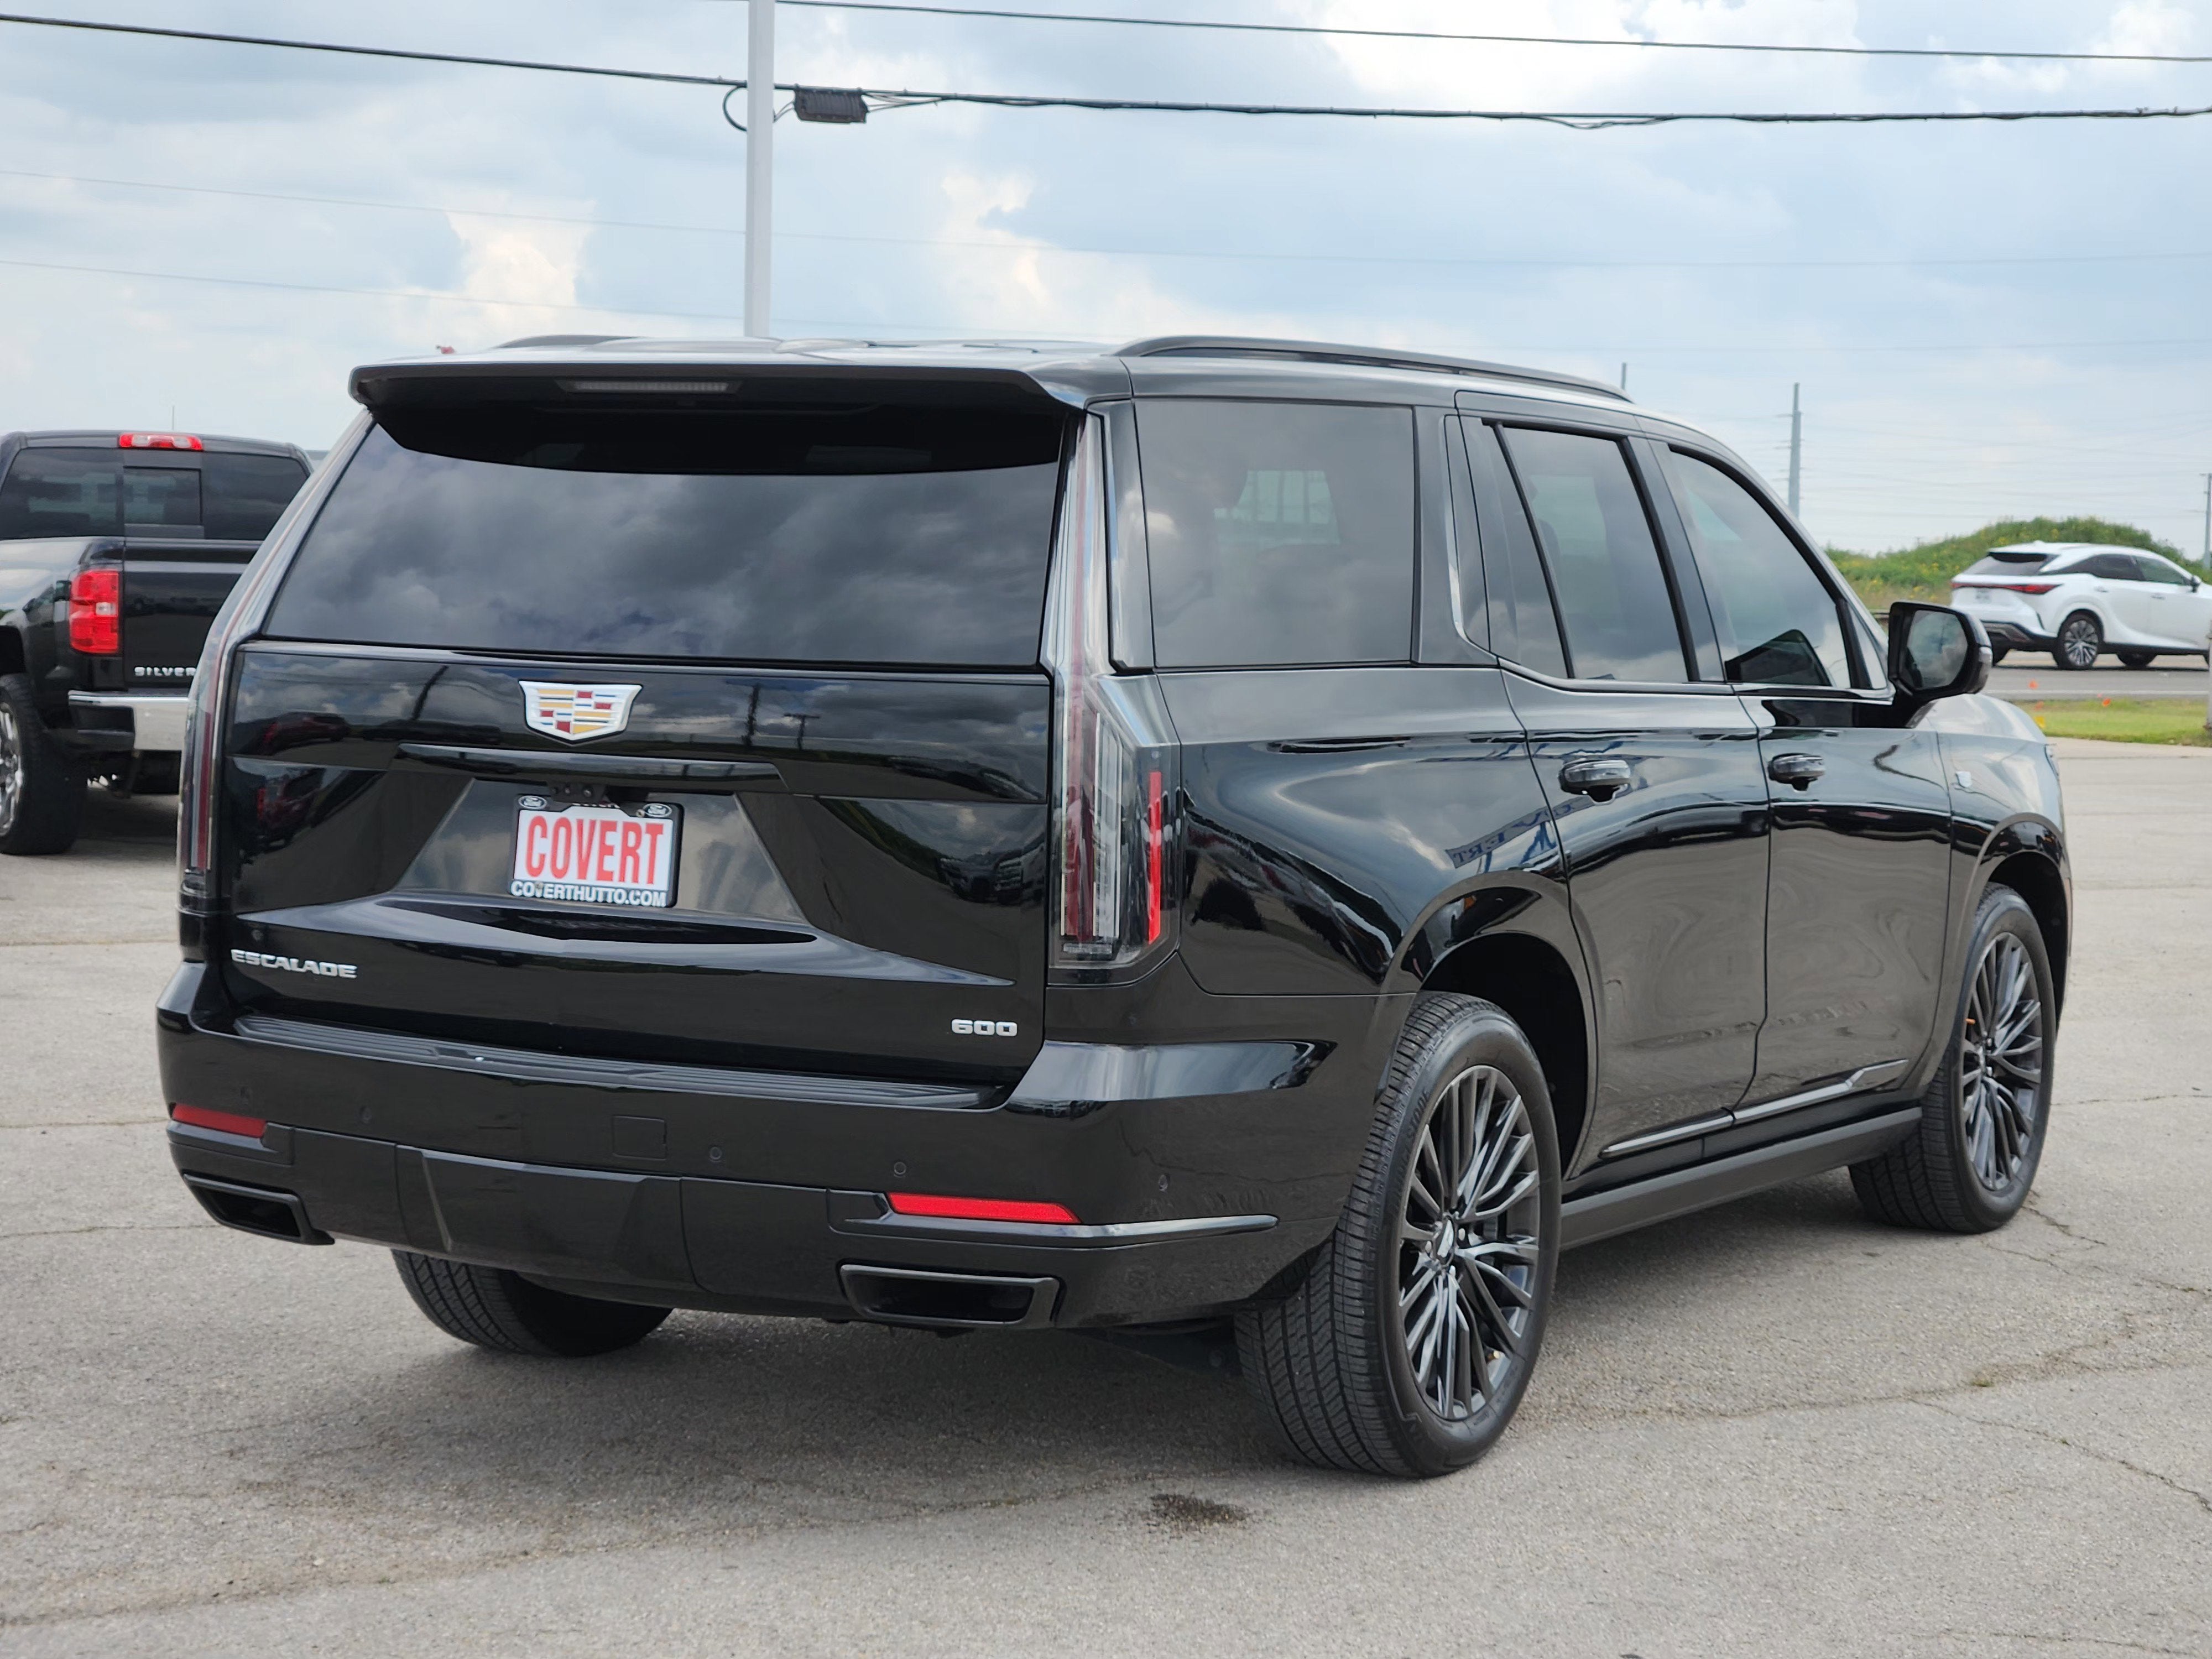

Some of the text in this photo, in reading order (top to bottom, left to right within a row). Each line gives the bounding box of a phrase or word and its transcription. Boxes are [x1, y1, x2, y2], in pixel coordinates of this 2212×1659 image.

[134, 666, 196, 676] SILVER
[526, 816, 664, 884] COVERT
[231, 949, 357, 979] ESCALADE
[951, 1019, 1018, 1037] 600
